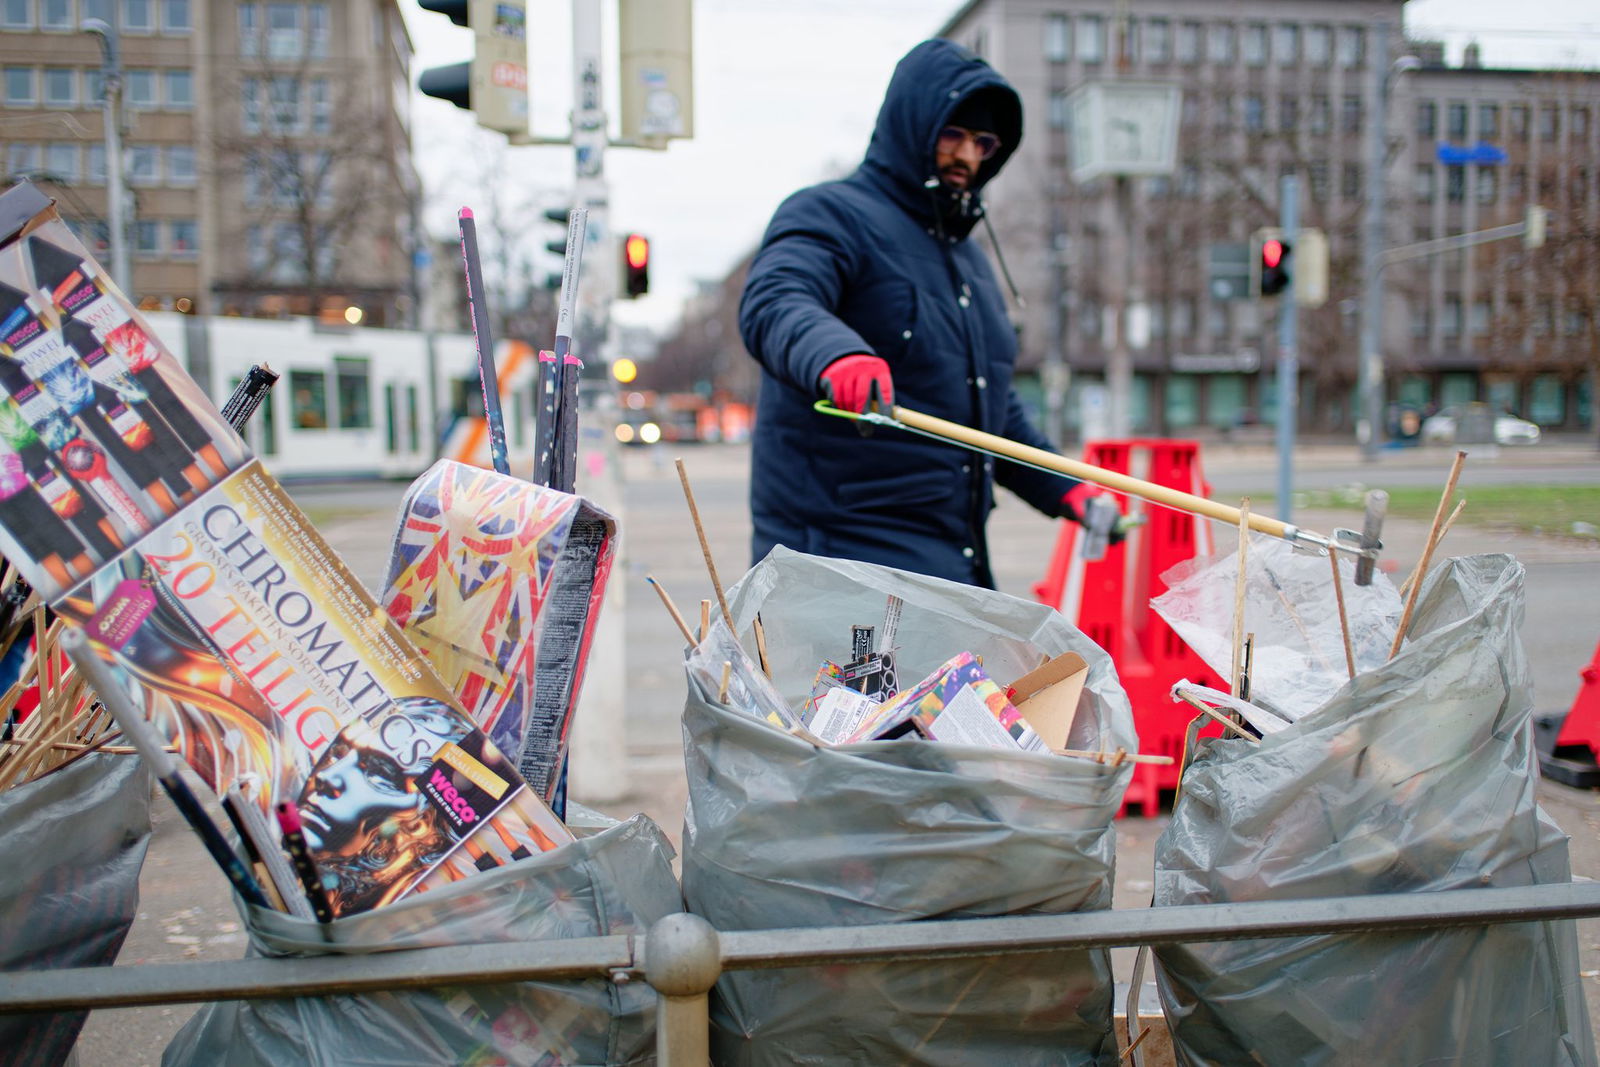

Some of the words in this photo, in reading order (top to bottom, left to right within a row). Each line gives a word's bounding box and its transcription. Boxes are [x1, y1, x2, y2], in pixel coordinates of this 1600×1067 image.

[250, 472, 266, 489] MIT
[183, 521, 235, 581] GROSSES
[96, 593, 130, 633] weco
[143, 530, 217, 600] 20
[206, 597, 342, 751] TEILIG
[202, 503, 432, 766] CHROMATICS
[427, 783, 464, 826] feuerwerk
[429, 768, 477, 823] weco
